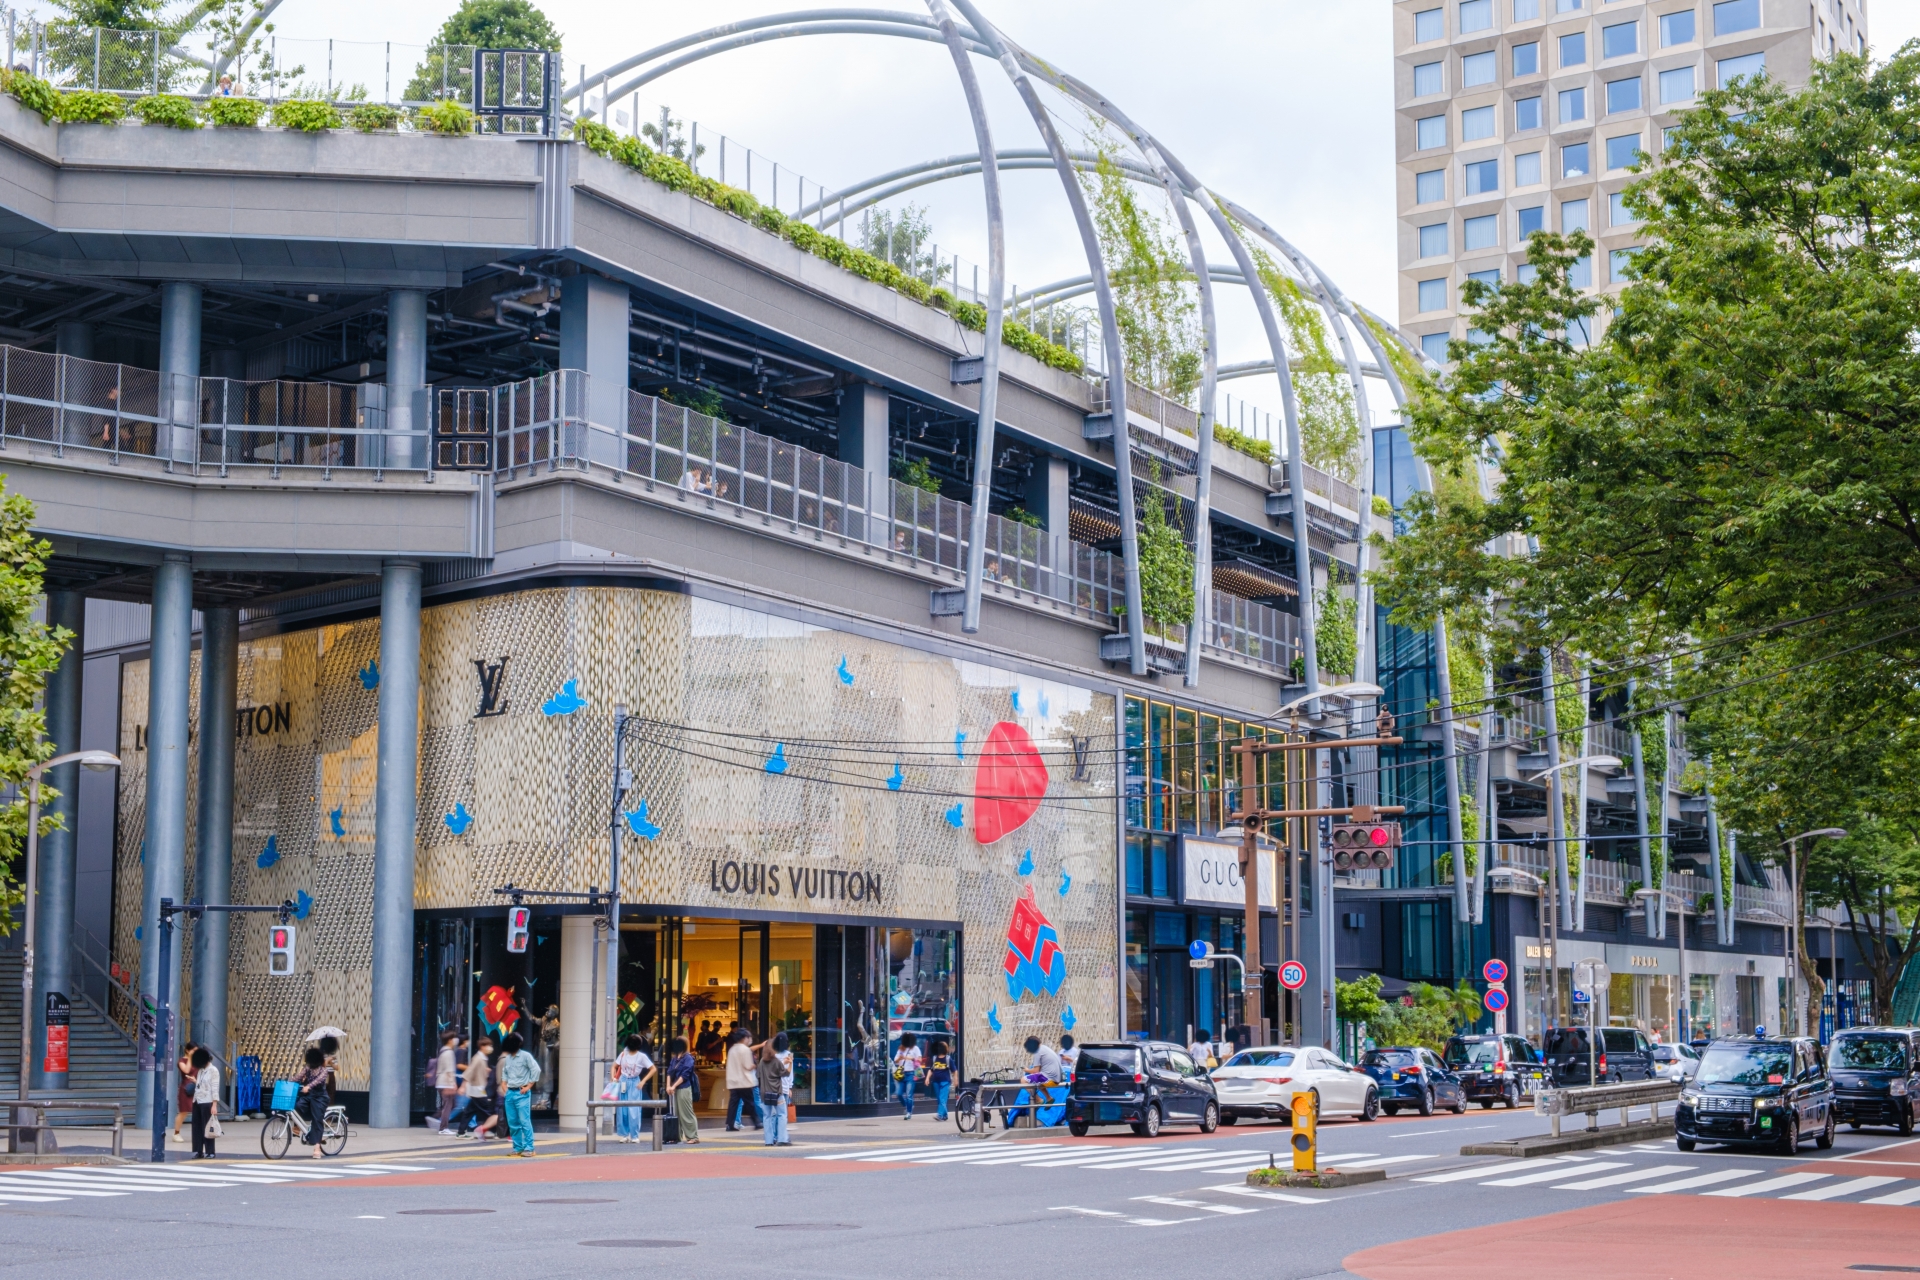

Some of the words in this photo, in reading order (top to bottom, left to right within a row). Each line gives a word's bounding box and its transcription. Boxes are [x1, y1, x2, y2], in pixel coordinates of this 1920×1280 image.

[237, 702, 290, 737] TTON
[711, 860, 780, 897] LOUIS
[788, 866, 881, 905] VUITTON
[1201, 859, 1245, 887] GUC
[1284, 969, 1301, 981] 50
[1631, 955, 1658, 967] PRADA
